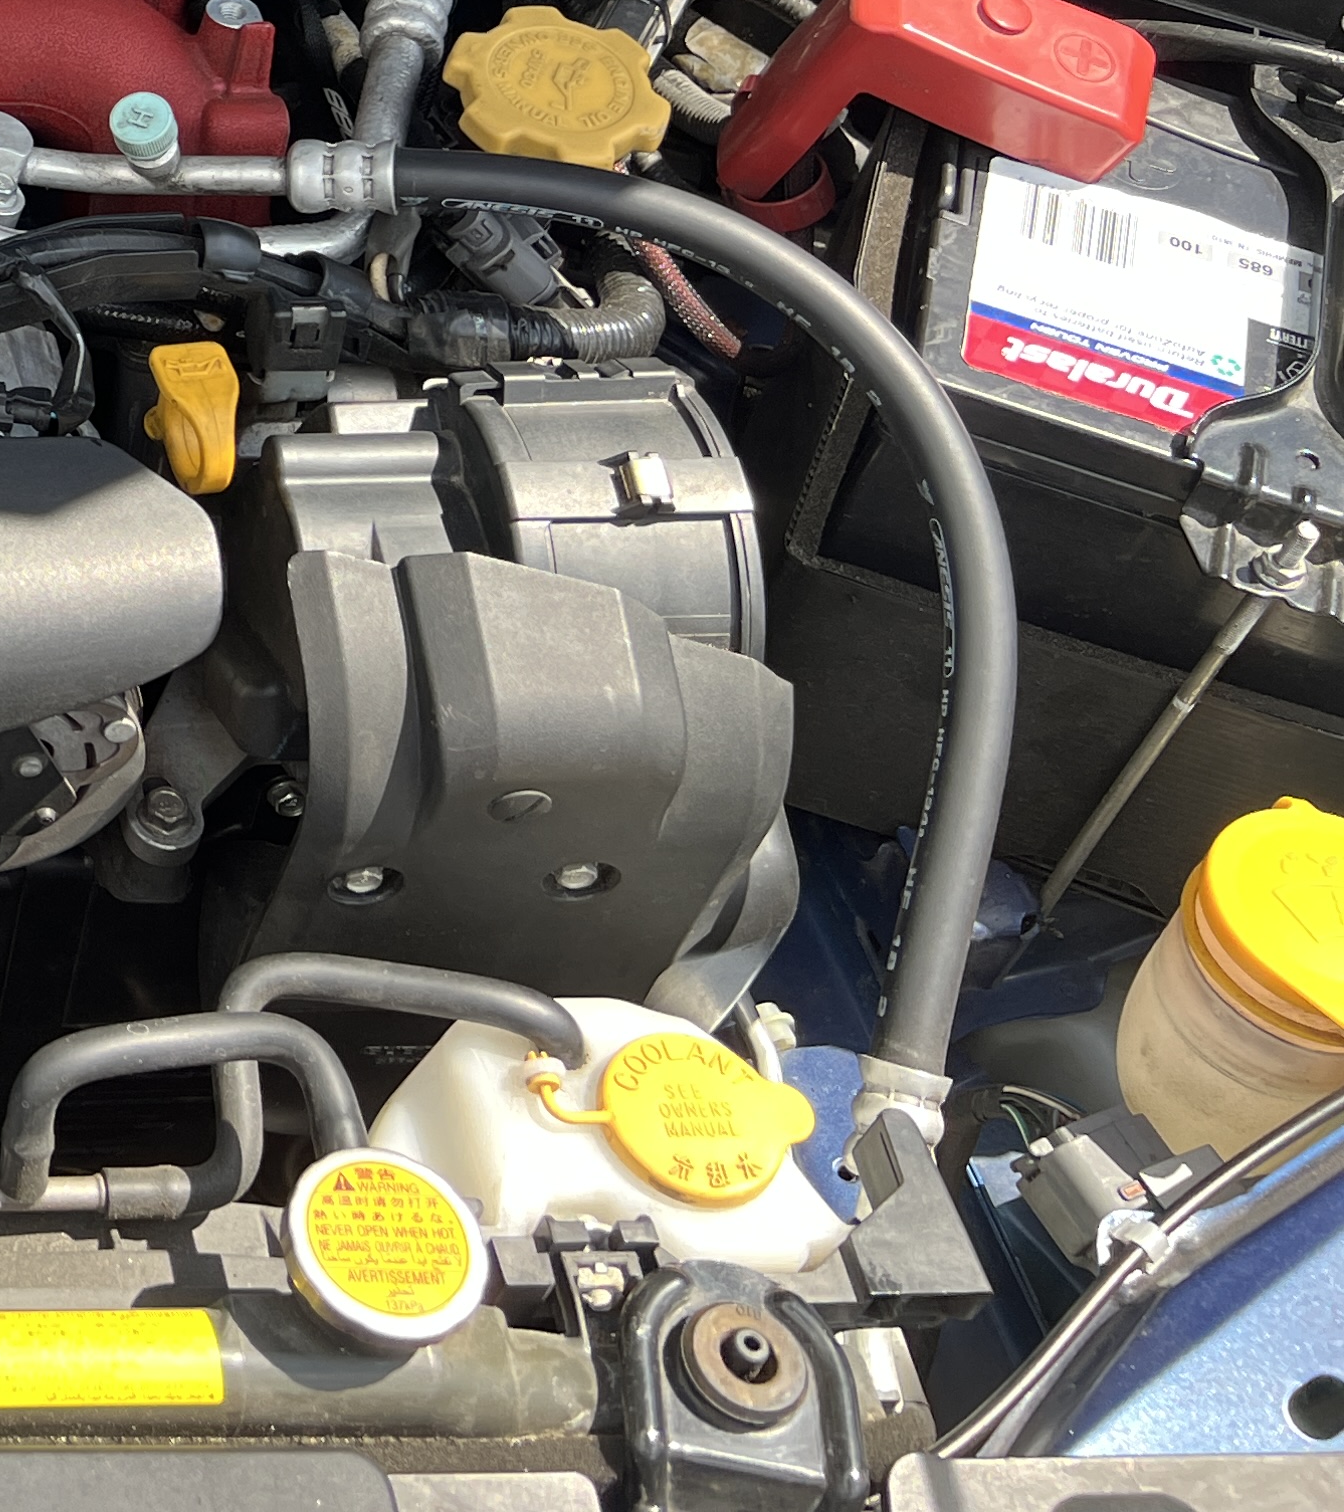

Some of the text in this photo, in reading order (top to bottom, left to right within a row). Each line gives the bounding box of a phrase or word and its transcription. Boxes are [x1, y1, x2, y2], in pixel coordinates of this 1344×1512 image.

[577, 54, 630, 129] ENGINE OIL
[127, 107, 154, 129] H
[1168, 235, 1203, 257] 100
[1238, 257, 1274, 278] 685
[1001, 335, 1194, 419] Duralast
[613, 1039, 755, 1092] COOLANT
[663, 1083, 702, 1100] SEE
[658, 1101, 733, 1119] OWNERS
[664, 1121, 738, 1138] MANUAL
[356, 1181, 420, 1195] WARNING
[315, 1223, 353, 1237] NEVER
[356, 1225, 389, 1239] OPEN
[392, 1226, 428, 1240] WHEN
[318, 1239, 331, 1251] NE
[336, 1240, 371, 1253] JAMAIS
[348, 1269, 446, 1285] AVERTISSEMENT
